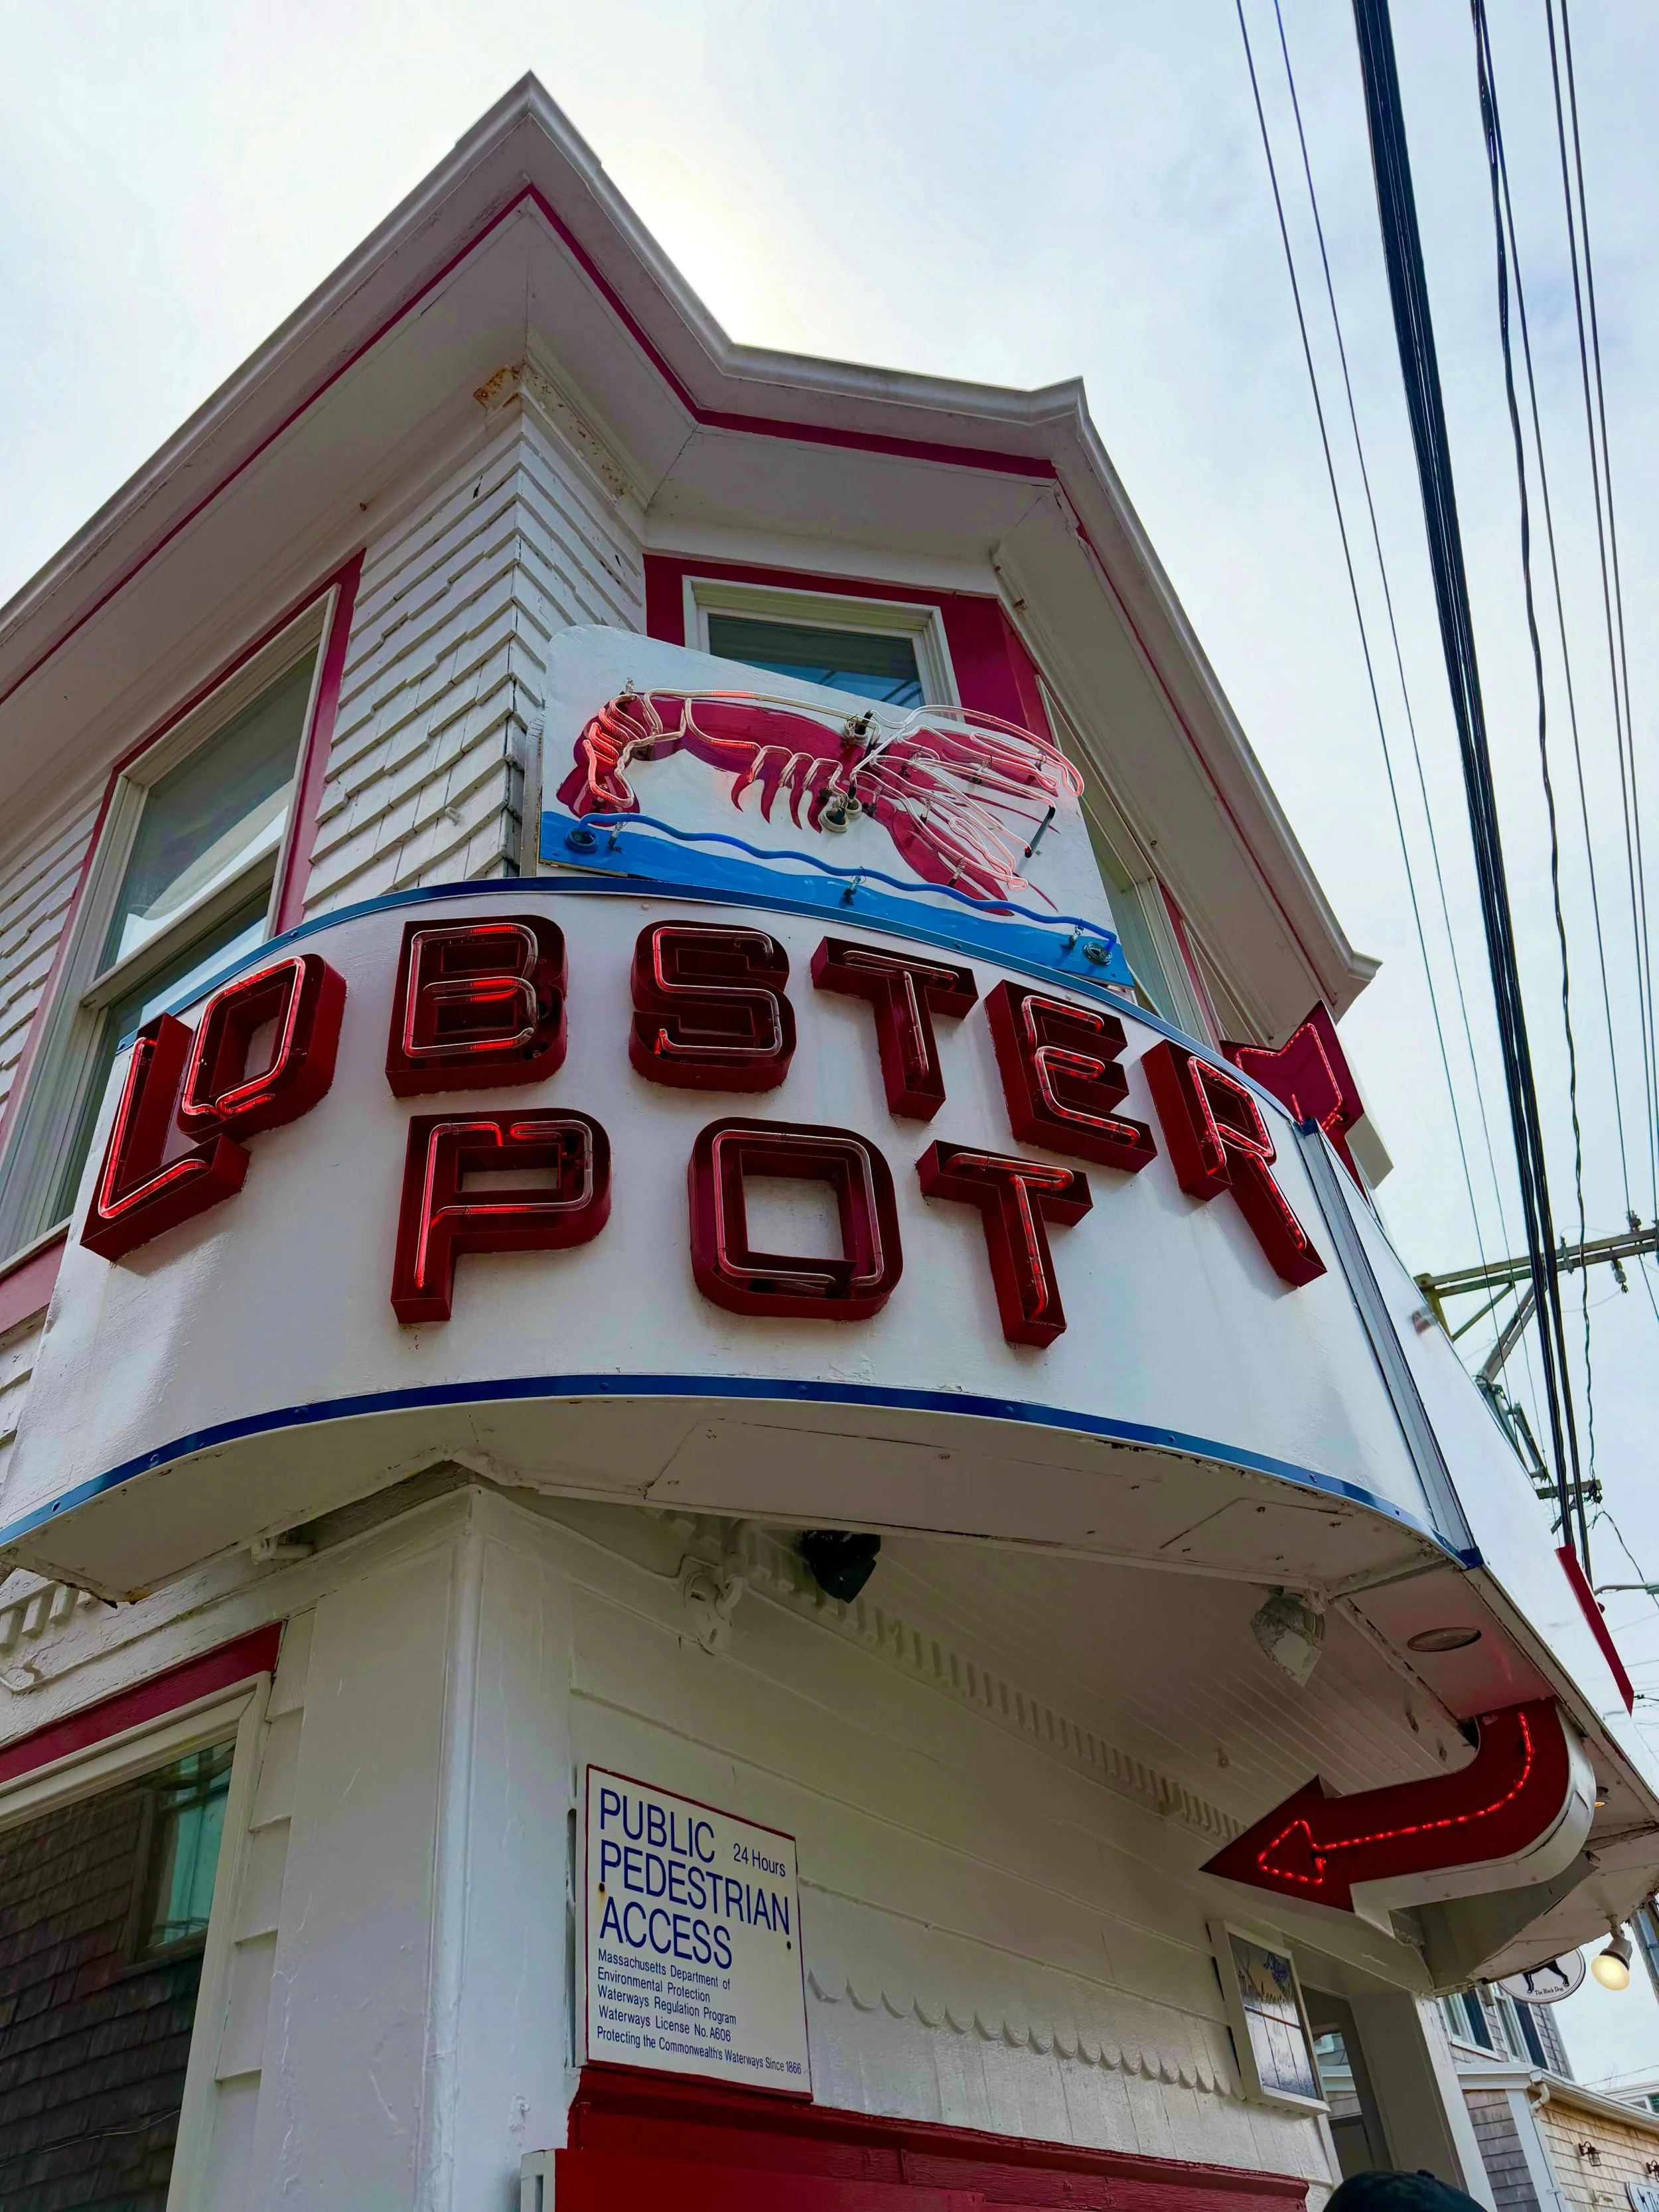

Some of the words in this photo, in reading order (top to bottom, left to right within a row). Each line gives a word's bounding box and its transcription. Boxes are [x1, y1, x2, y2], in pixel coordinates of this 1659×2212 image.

[80, 914, 1327, 1287] LOBSTER
[391, 1107, 1093, 1349] POT
[601, 1788, 715, 1863] PUBLIC
[734, 1843, 749, 1864] 24
[753, 1849, 786, 1877] Hours
[601, 1839, 790, 1935] PEDESTRIAN
[600, 1896, 732, 1969] ACCESS
[598, 1966, 662, 1992] Environmental
[668, 1982, 710, 2003] Protection
[599, 1948, 666, 1975] Massachusetts
[670, 1964, 718, 1987] Department
[723, 1979, 730, 1990] of
[597, 1984, 649, 2008] Waterways
[654, 1996, 699, 2018] Regulation
[703, 2007, 736, 2025] Program
[599, 2004, 650, 2028] Waterways
[656, 2015, 689, 2034] License
[694, 2023, 707, 2037] No.
[710, 2026, 731, 2042] A606
[597, 2026, 640, 2048] Protecting
[643, 2034, 656, 2048] the
[659, 2037, 723, 2060] Commonwealth's
[725, 2049, 763, 2069] Waterways
[765, 2057, 784, 2071] Since
[786, 2061, 801, 2074] 1866
